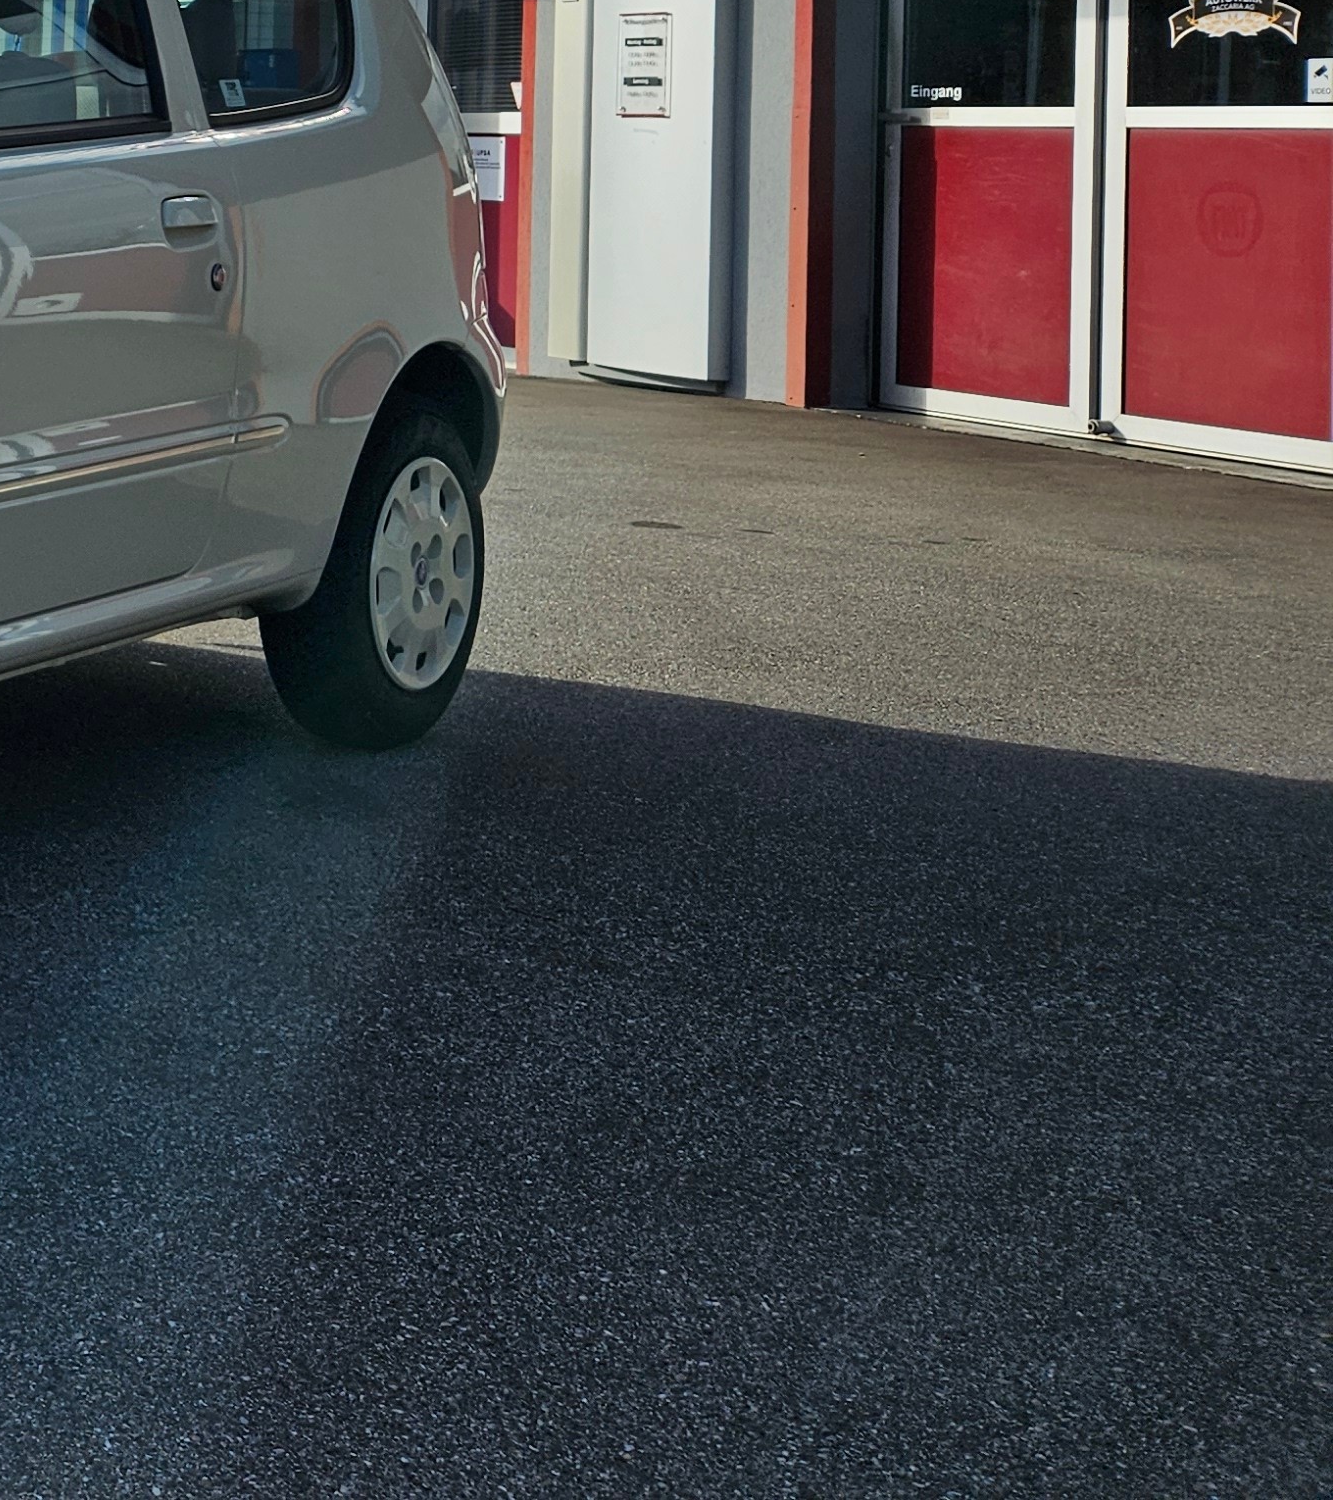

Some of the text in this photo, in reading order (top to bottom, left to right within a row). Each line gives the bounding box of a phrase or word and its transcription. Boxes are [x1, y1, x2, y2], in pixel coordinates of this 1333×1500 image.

[1211, 3, 1256, 12] ZACCARIA AG
[910, 84, 963, 102] Eingang
[1310, 87, 1331, 95] VIDEO
